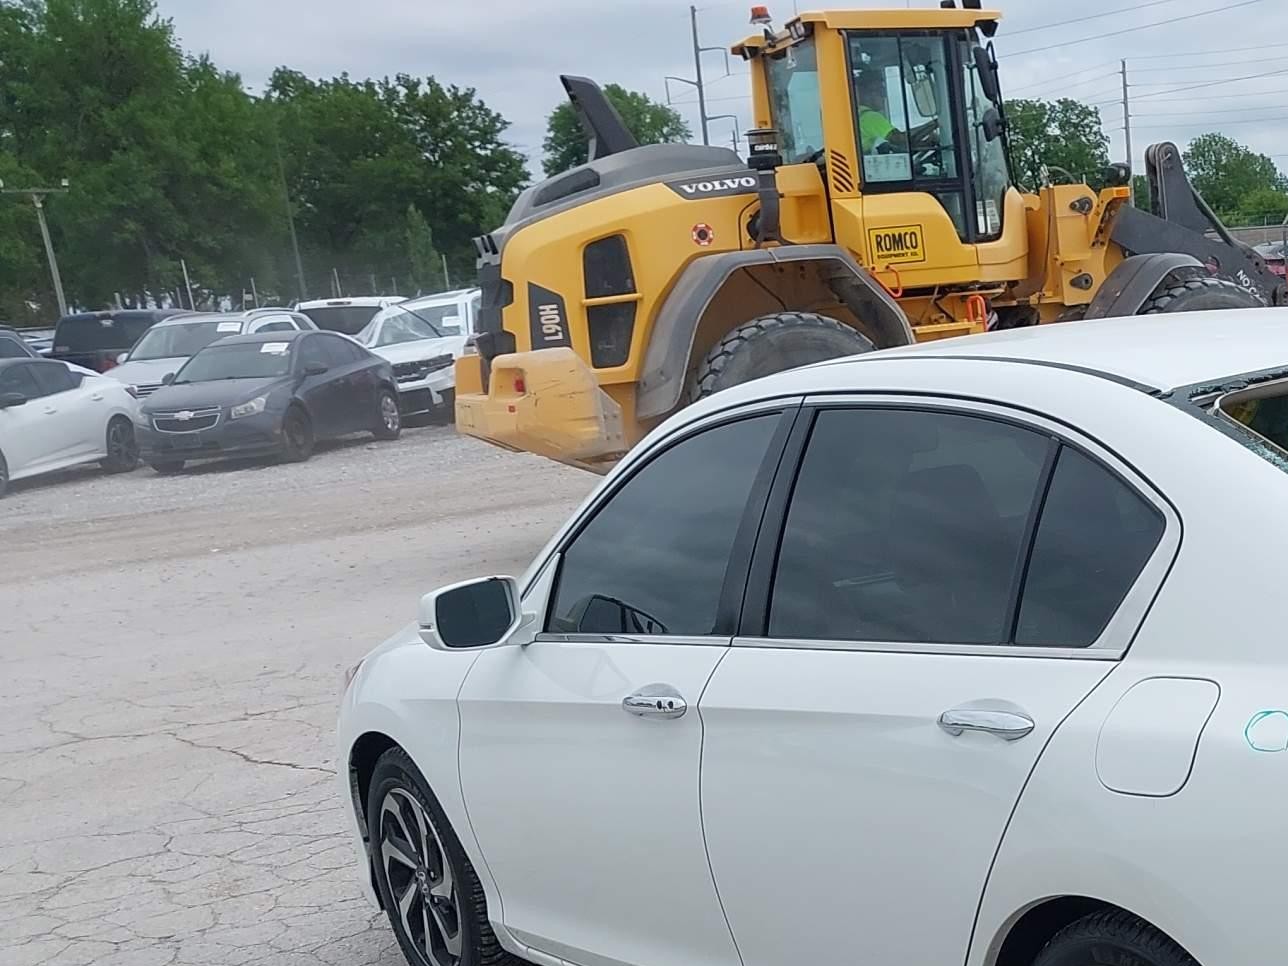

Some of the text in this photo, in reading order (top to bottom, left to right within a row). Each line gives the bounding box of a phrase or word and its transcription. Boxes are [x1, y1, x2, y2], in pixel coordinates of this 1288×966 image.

[680, 176, 756, 194] VOLVO
[875, 231, 918, 253] ROMCO
[1237, 269, 1250, 286] NO
[538, 304, 564, 341] L90H
